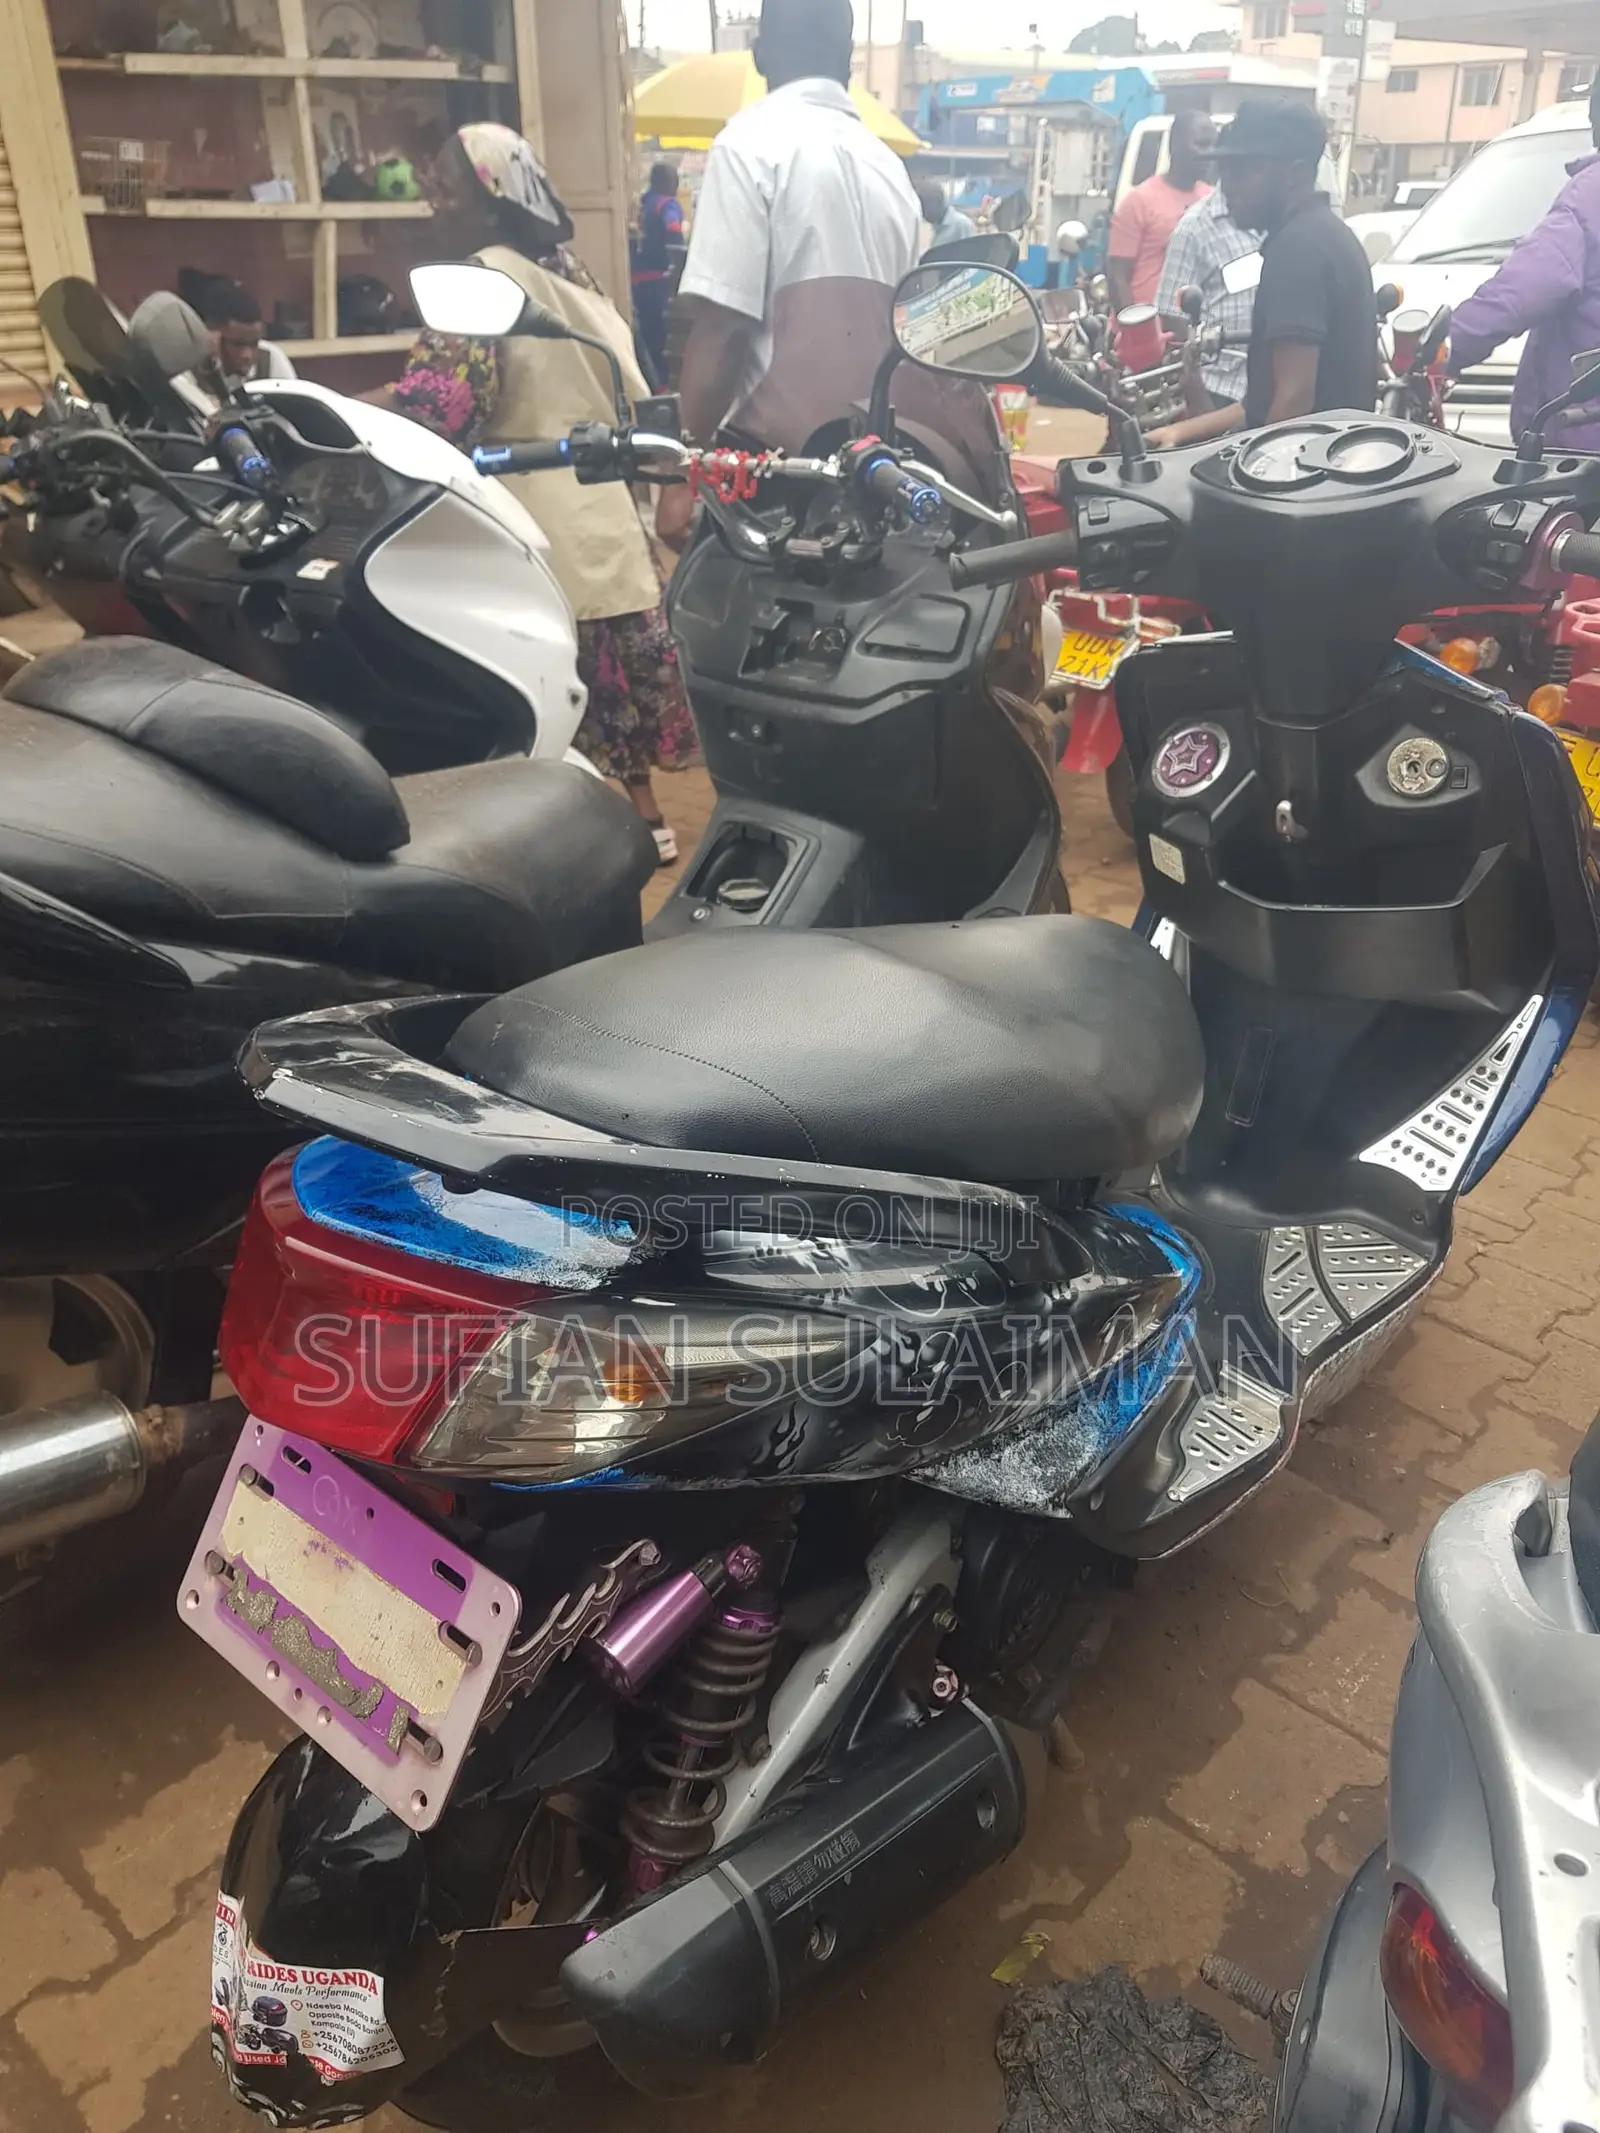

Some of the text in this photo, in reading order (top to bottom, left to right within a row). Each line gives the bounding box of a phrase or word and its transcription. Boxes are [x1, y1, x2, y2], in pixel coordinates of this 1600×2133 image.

[269, 1980, 303, 1996] Meets
[301, 1969, 379, 1997] UGANDA
[306, 2002, 341, 2010] Ndeeba
[308, 2011, 345, 2021] Opposite
[310, 2020, 346, 2032] Kampala
